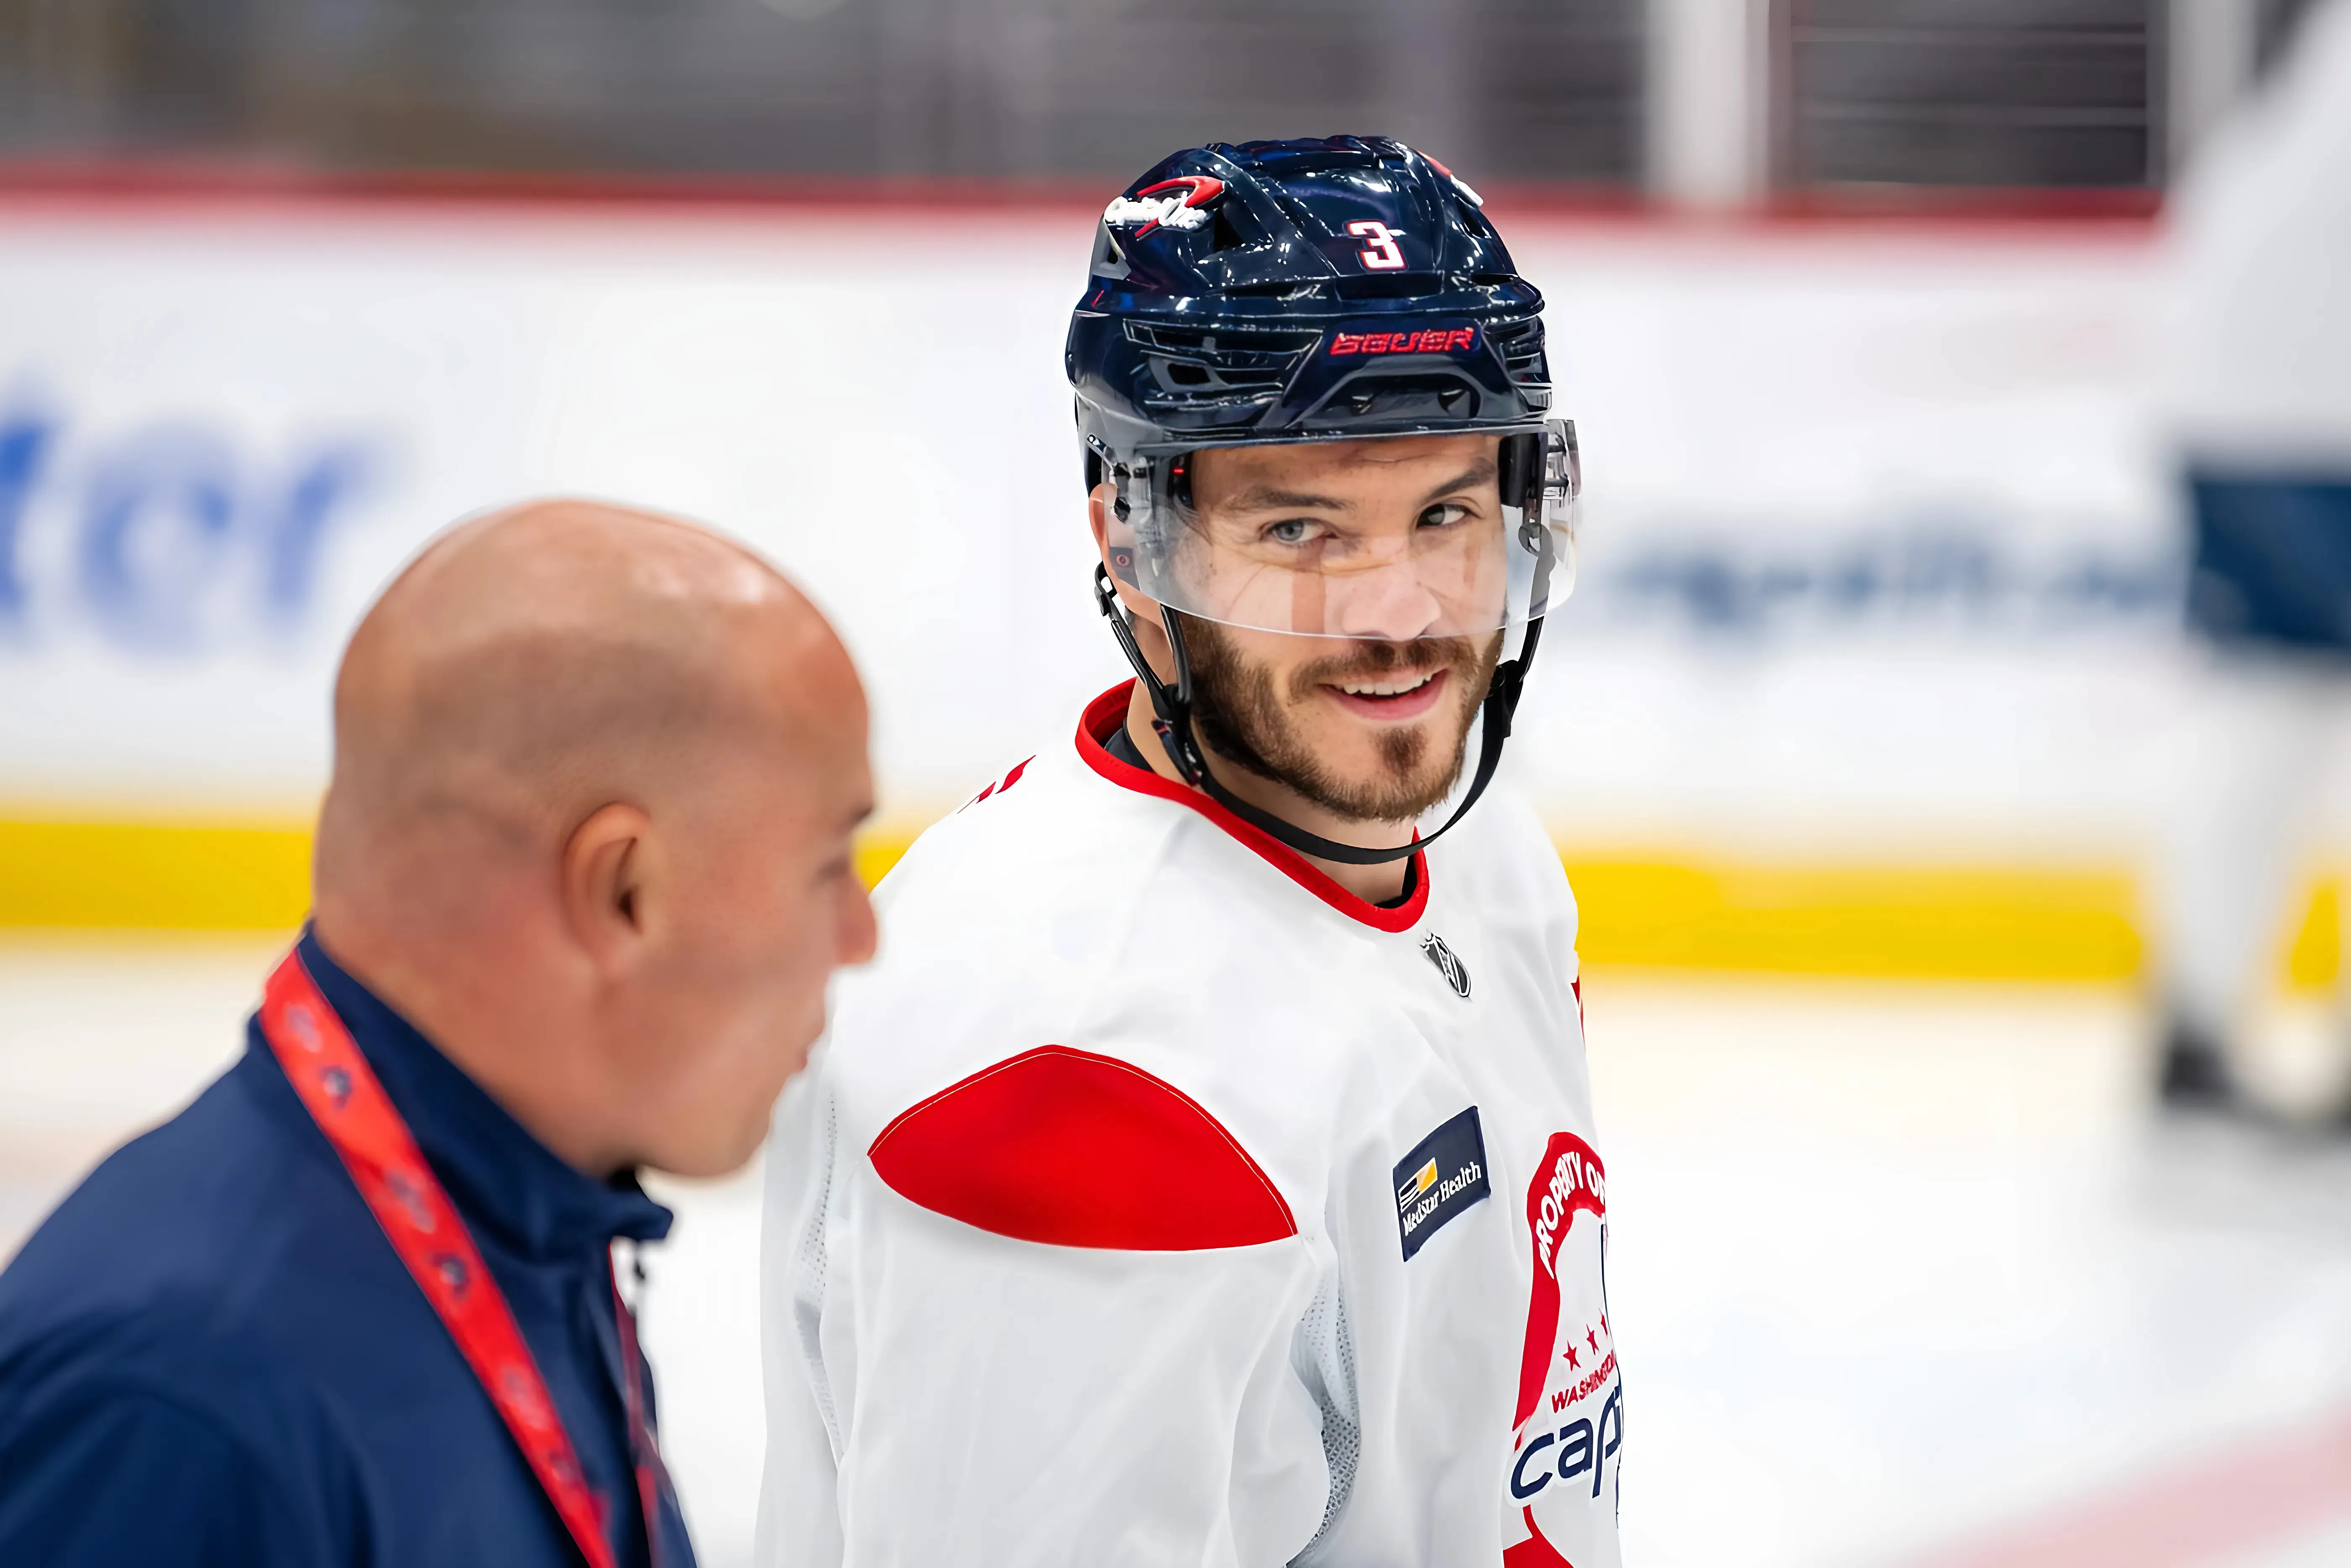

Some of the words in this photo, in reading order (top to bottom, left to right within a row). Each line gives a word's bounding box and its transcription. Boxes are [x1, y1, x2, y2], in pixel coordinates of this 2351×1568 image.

[1347, 221, 1408, 269] 3
[1330, 327, 1474, 355] BAUER
[1440, 1161, 1482, 1202] Health
[1552, 1348, 1616, 1413] WASHINGTO
